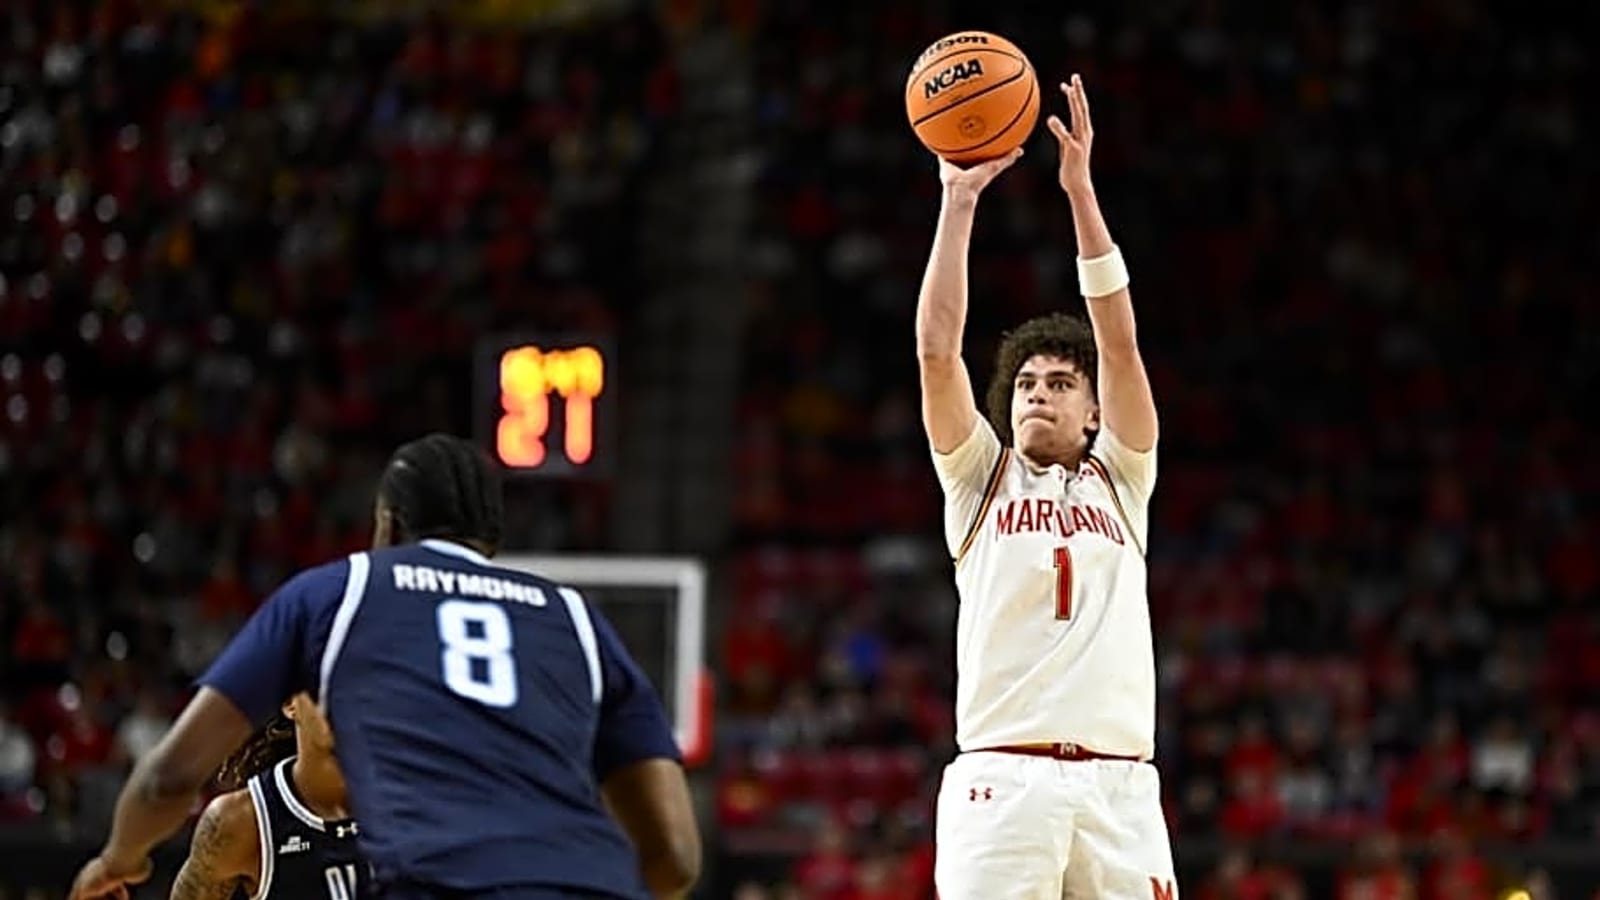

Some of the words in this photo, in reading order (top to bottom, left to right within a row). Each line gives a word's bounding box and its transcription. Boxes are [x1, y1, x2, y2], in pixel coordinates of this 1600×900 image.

[925, 59, 984, 99] NCAA
[996, 498, 1125, 546] MARLAND
[392, 563, 548, 607] RAYMOND
[1053, 546, 1073, 620] 1
[436, 599, 519, 708] 8
[1150, 876, 1174, 900] M
